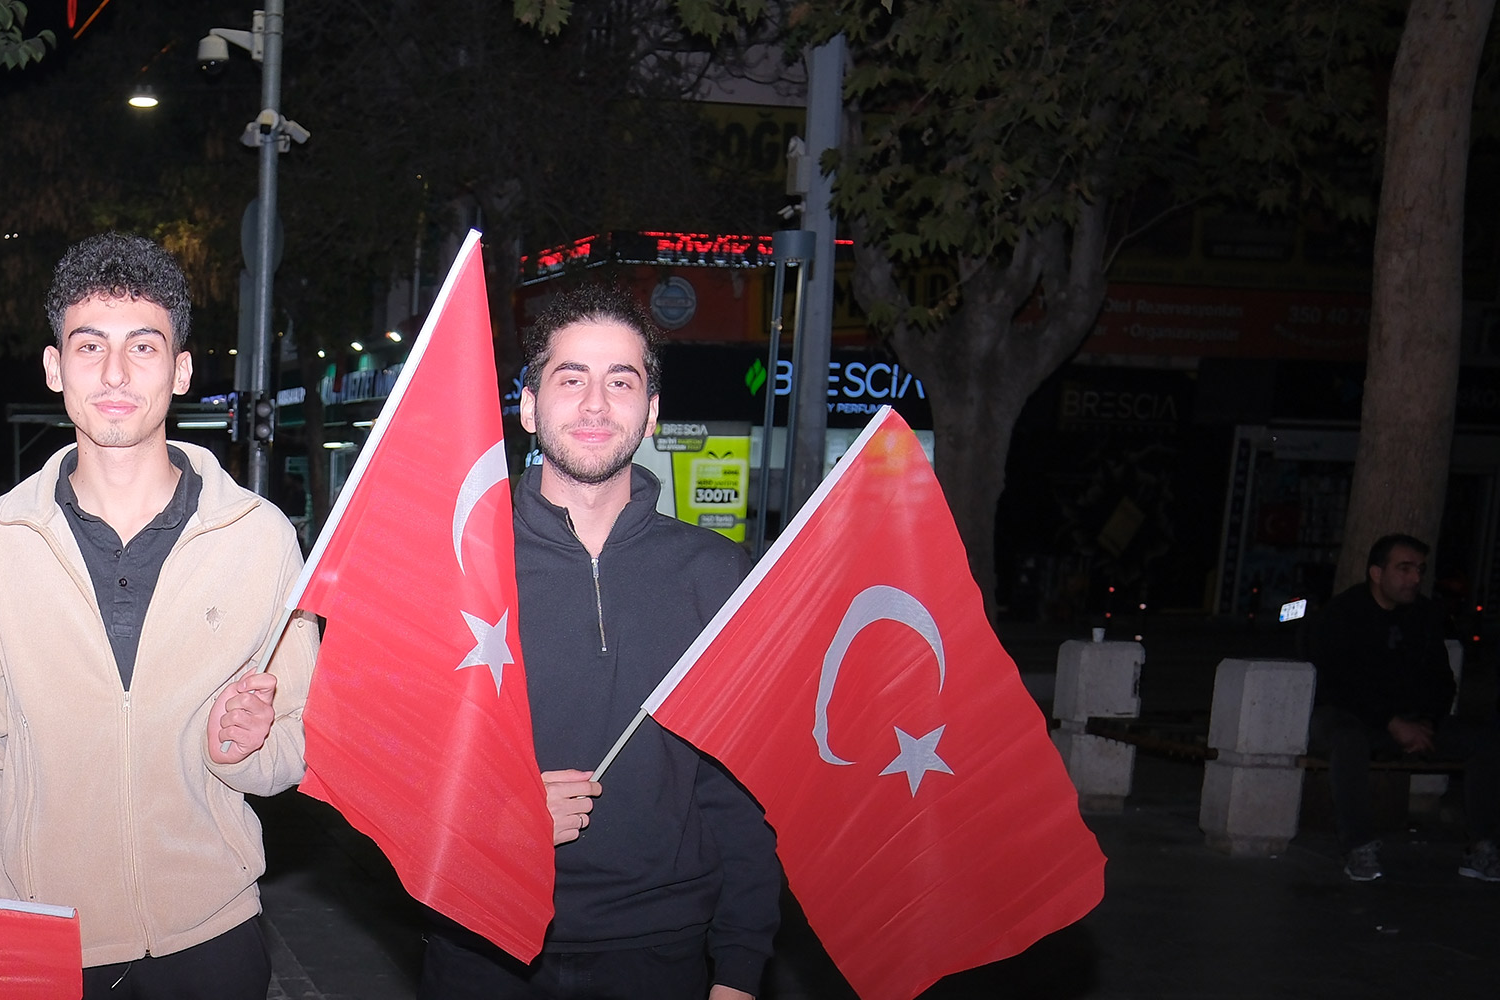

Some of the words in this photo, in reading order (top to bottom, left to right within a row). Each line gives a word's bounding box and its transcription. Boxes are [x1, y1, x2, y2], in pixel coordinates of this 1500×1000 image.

[1061, 390, 1180, 419] BRESCIA
[661, 423, 708, 436] BRESCIA
[696, 488, 739, 503] 300TL
